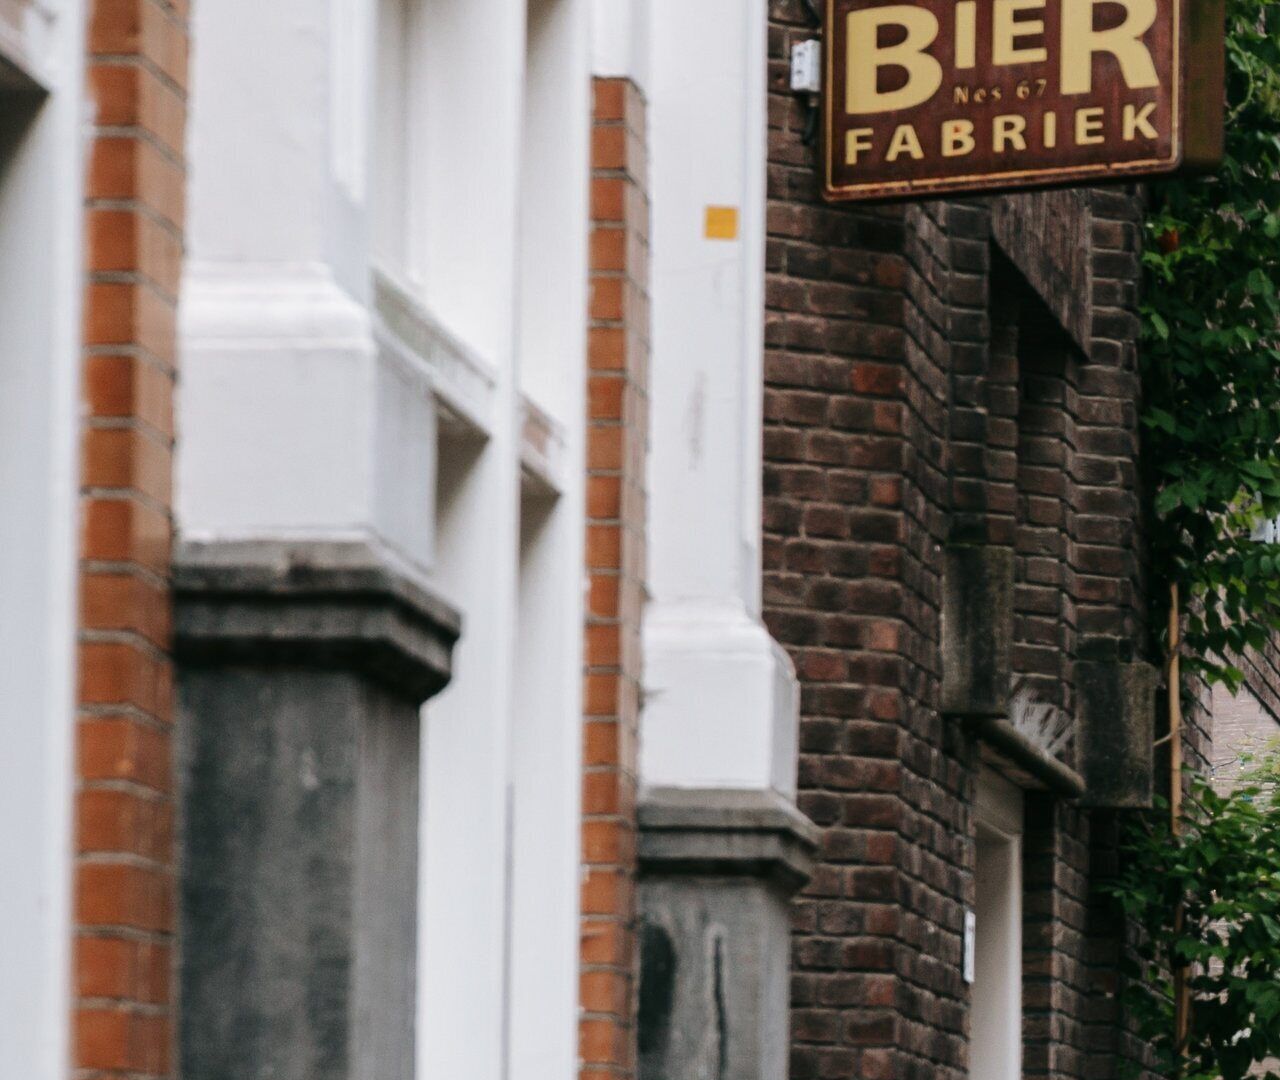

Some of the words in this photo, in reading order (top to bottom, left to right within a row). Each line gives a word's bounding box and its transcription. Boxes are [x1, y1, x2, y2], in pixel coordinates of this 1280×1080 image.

[845, 0, 1160, 114] BIER
[1016, 79, 1047, 100] 67
[845, 102, 1159, 165] FABRIEK
